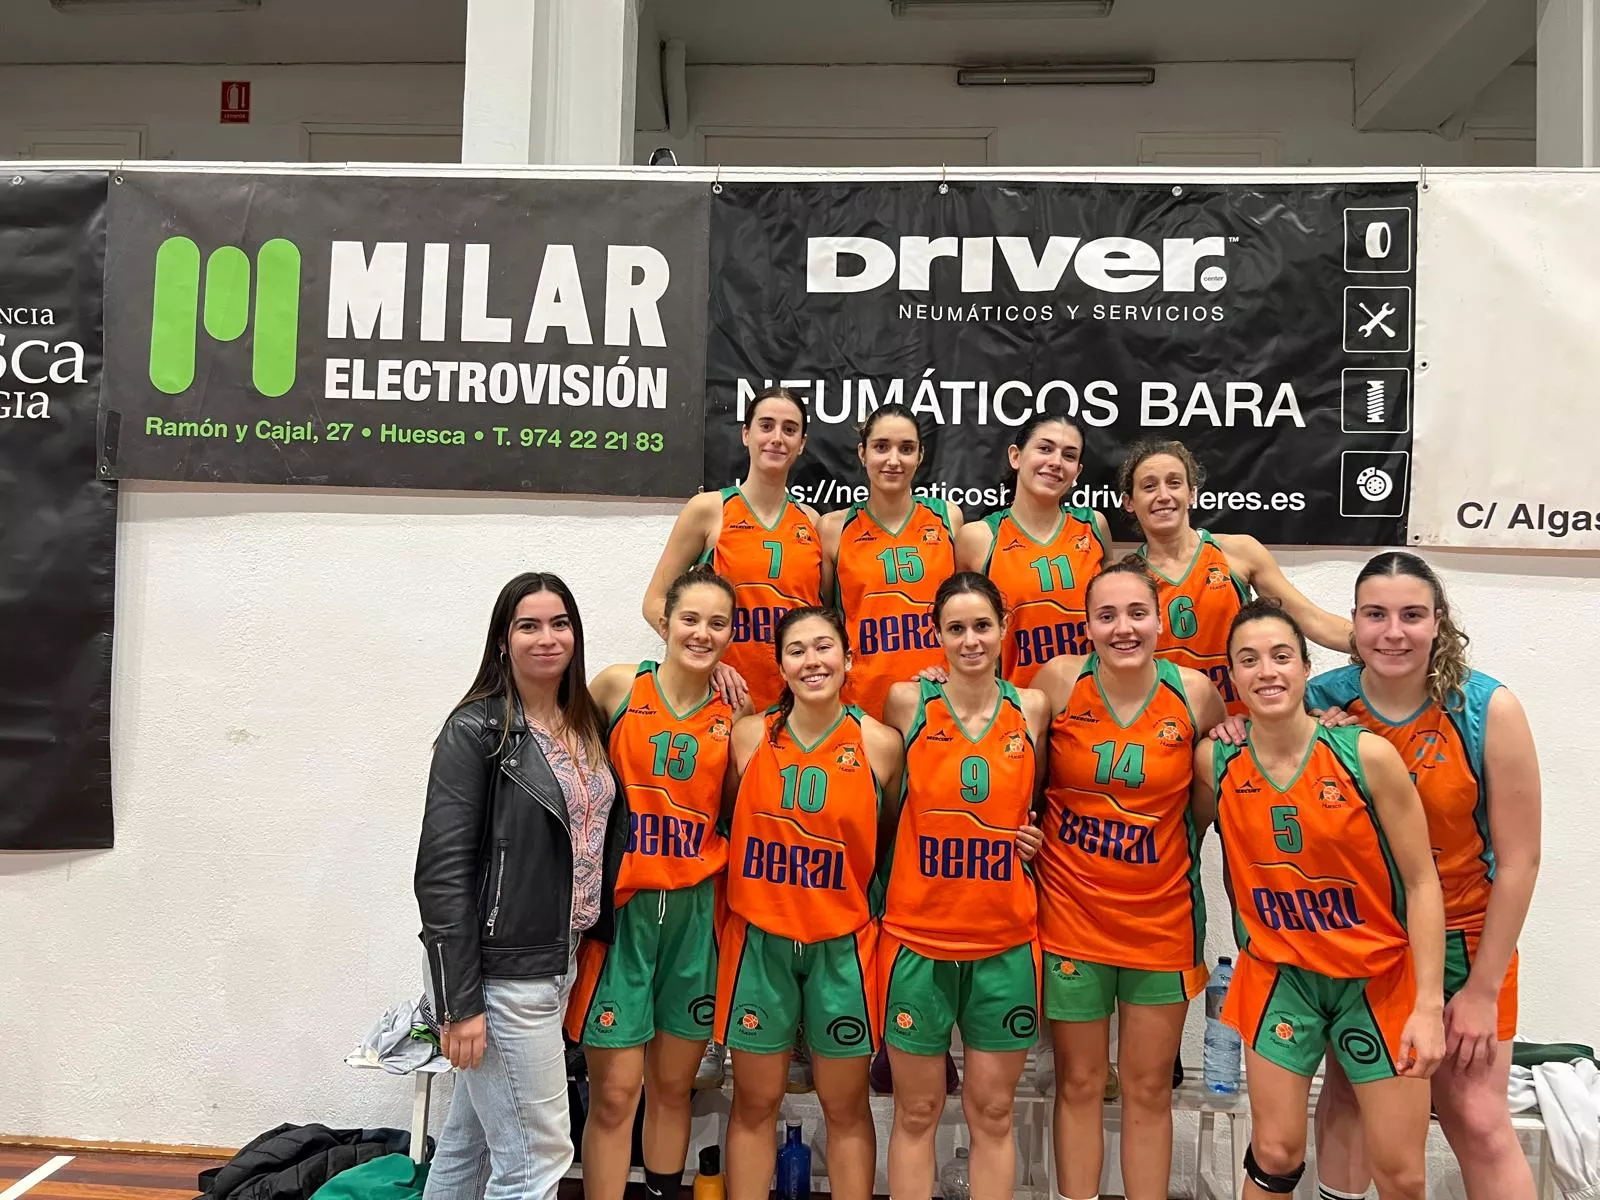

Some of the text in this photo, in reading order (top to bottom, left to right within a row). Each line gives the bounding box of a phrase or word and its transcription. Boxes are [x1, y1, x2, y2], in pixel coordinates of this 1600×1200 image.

[327, 240, 669, 347] MILAR
[899, 303, 1224, 321] NEUMÁTICOS Y SERVICIOS
[324, 355, 668, 409] ELECTROVISIÓN
[1139, 381, 1306, 428] BARA
[145, 416, 664, 452] Ramón y Cajal, 27 Huesca T. 974 22 21 83
[1457, 502, 1498, 530] C/
[762, 540, 784, 580] 7
[875, 546, 926, 585] 15
[1029, 554, 1076, 593] 11
[1167, 595, 1199, 640] 6
[648, 730, 699, 782] 13
[959, 755, 990, 804] 9
[1091, 740, 1147, 790] 14
[779, 763, 828, 814] 10
[1270, 805, 1304, 854] 5
